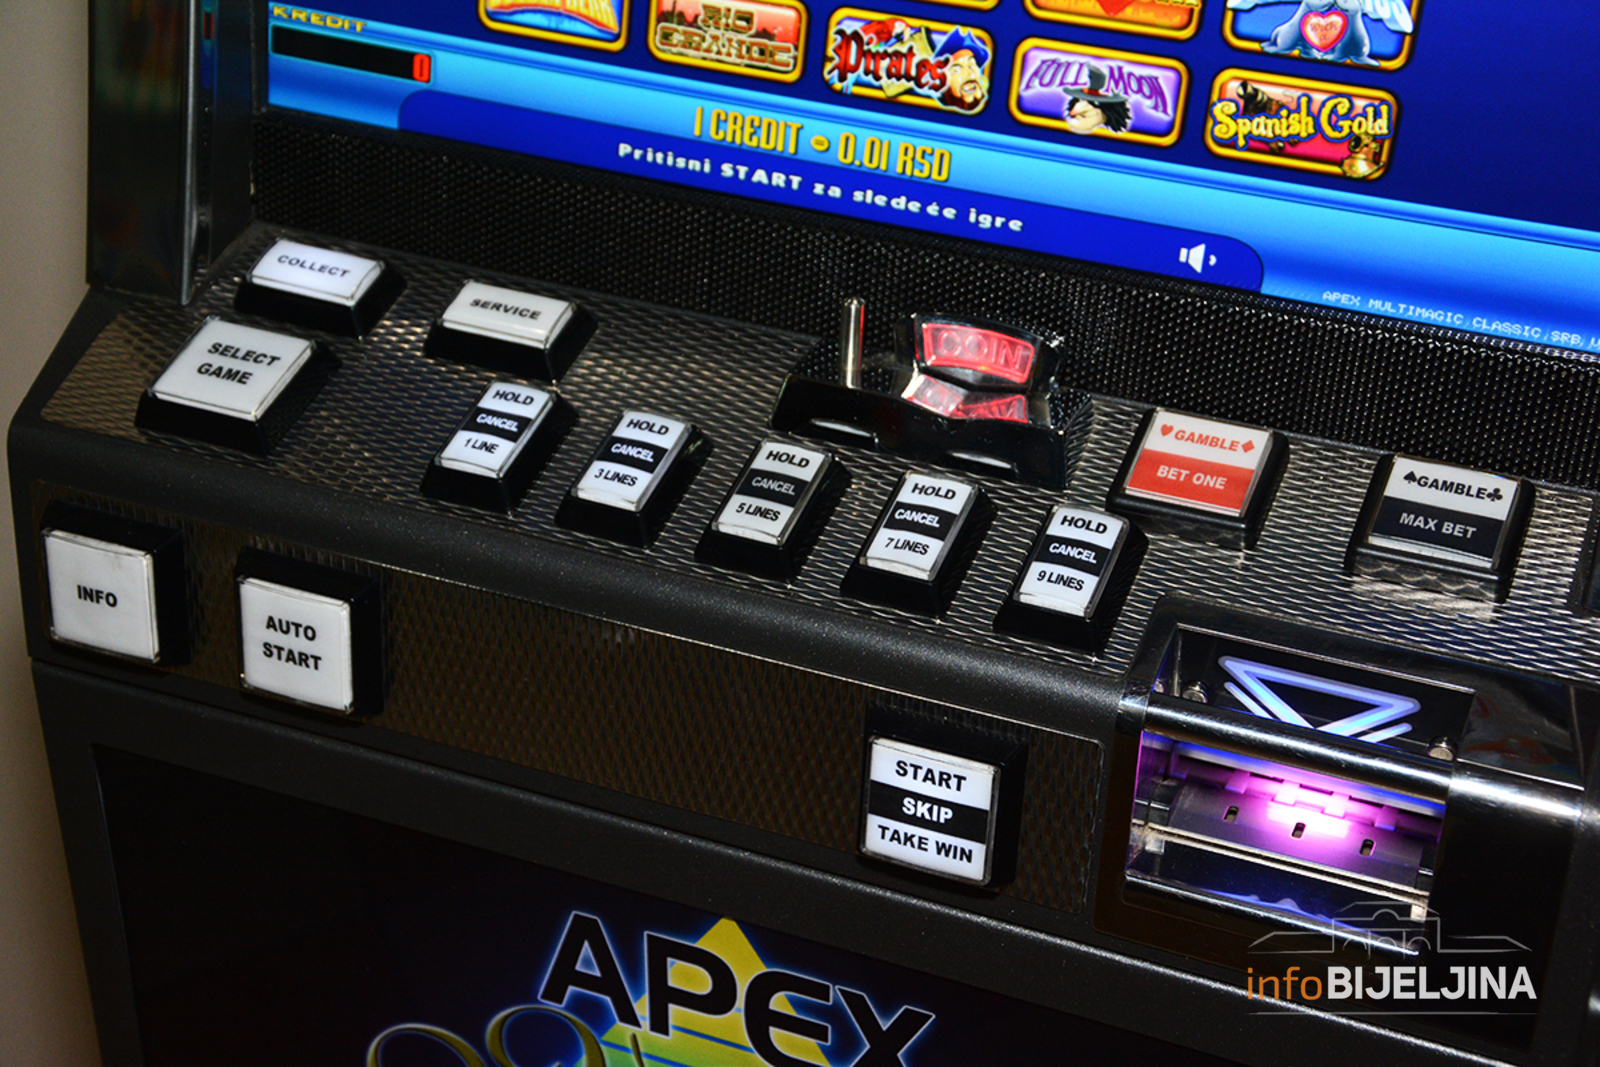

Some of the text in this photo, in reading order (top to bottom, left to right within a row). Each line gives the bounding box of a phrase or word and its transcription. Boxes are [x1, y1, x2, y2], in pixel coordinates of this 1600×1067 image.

[272, 4, 367, 33] KREDIT
[699, 4, 756, 34] RIO
[657, 23, 795, 70] GRANDE
[413, 53, 431, 83] 0
[827, 28, 950, 91] Pirates
[1212, 94, 1393, 149] Spanish Gold
[709, 108, 803, 155] CREDIT
[837, 131, 890, 171] 0.01
[896, 140, 951, 182] RSD
[618, 142, 712, 175] Pritisni
[720, 162, 803, 190] START
[812, 182, 843, 199] za
[968, 206, 1025, 232] igre
[277, 254, 351, 279] COLLECT
[469, 297, 542, 321] SERVICE
[1322, 289, 1361, 307] APEX
[207, 341, 281, 367] SELECT
[937, 329, 1024, 371] COIN
[196, 362, 253, 385] GAME
[492, 388, 535, 406] HOLD
[476, 412, 520, 432] CANCEL
[626, 417, 670, 436] HOLD
[464, 437, 500, 455] 1 LINE
[610, 442, 655, 463] CANCEL
[1174, 428, 1241, 453] GAMBLE
[765, 450, 811, 469] HOLD
[594, 467, 639, 487] 3 LINES
[751, 475, 796, 496] CANCEL
[1156, 464, 1228, 490] BET ONE
[1415, 474, 1488, 501] GAMBLE
[910, 482, 957, 501] HOLD
[735, 502, 782, 522] 5 LINES
[894, 508, 941, 529] CANCEL
[1059, 514, 1108, 535] HOLD
[1398, 511, 1477, 540] MAX BET
[885, 537, 930, 556] 7 LINES
[1049, 542, 1098, 564] CANCEL
[1036, 569, 1086, 592] 9 LINES
[76, 583, 118, 608] INFO
[265, 614, 317, 642] AUTO
[262, 641, 322, 671] START
[895, 759, 967, 792] START
[901, 796, 954, 824] SKIP
[877, 824, 973, 864] TAKE WIN
[536, 909, 936, 1067] APEX
